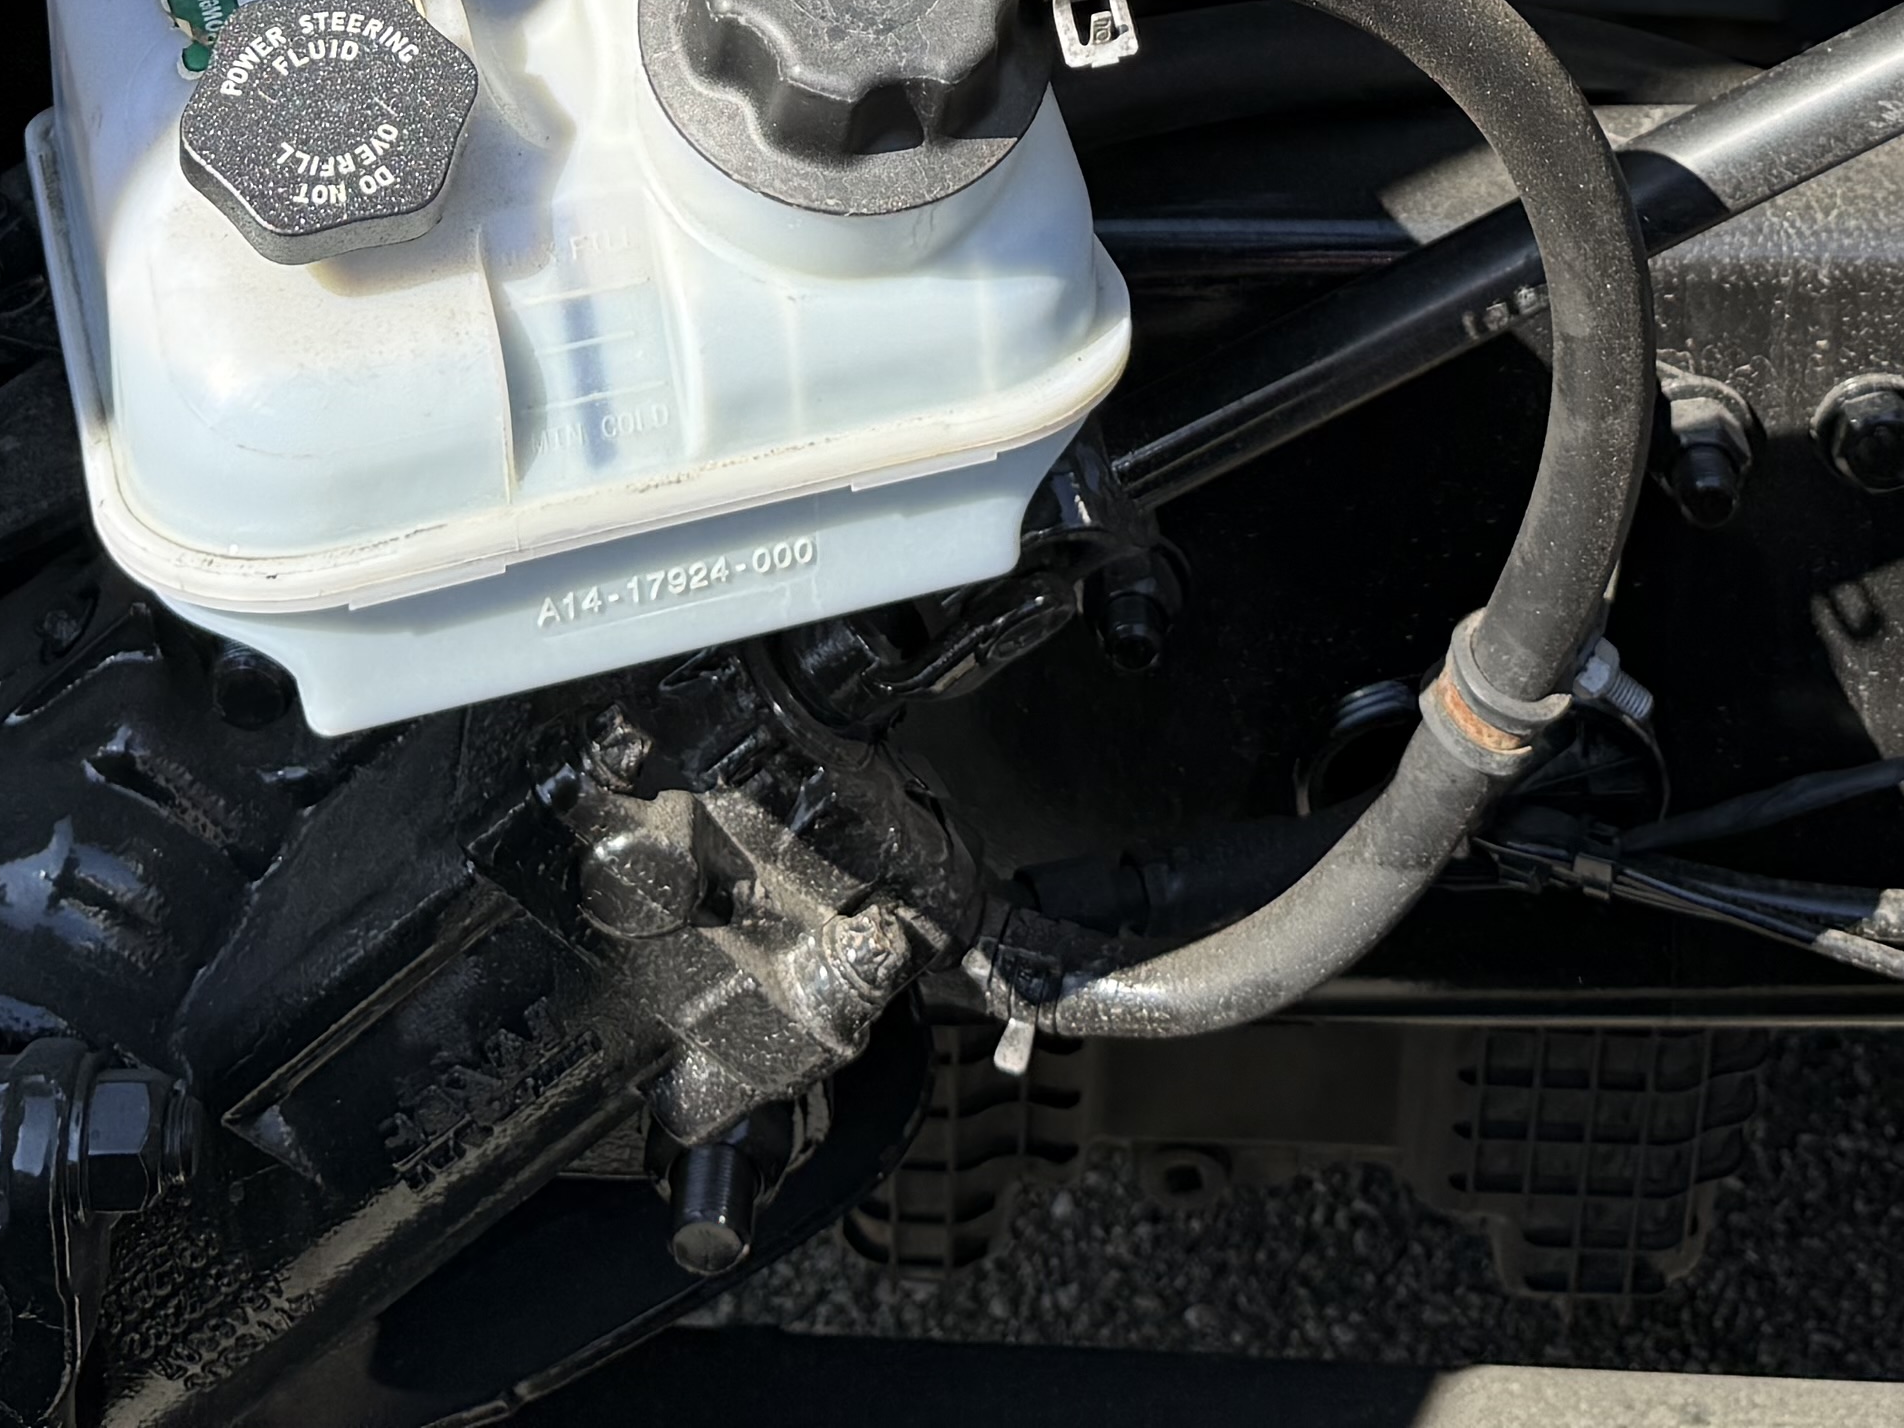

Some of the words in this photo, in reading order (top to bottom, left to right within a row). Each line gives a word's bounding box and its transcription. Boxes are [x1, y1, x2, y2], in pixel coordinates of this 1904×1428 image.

[220, 25, 287, 97] POWER
[299, 11, 420, 64] STEERING
[272, 40, 358, 76] FLUID
[276, 123, 399, 178] OVERFILL
[294, 184, 347, 206] NOT
[359, 170, 395, 195] DO
[601, 404, 669, 441] COLD
[537, 537, 818, 628] A14-17924-000
